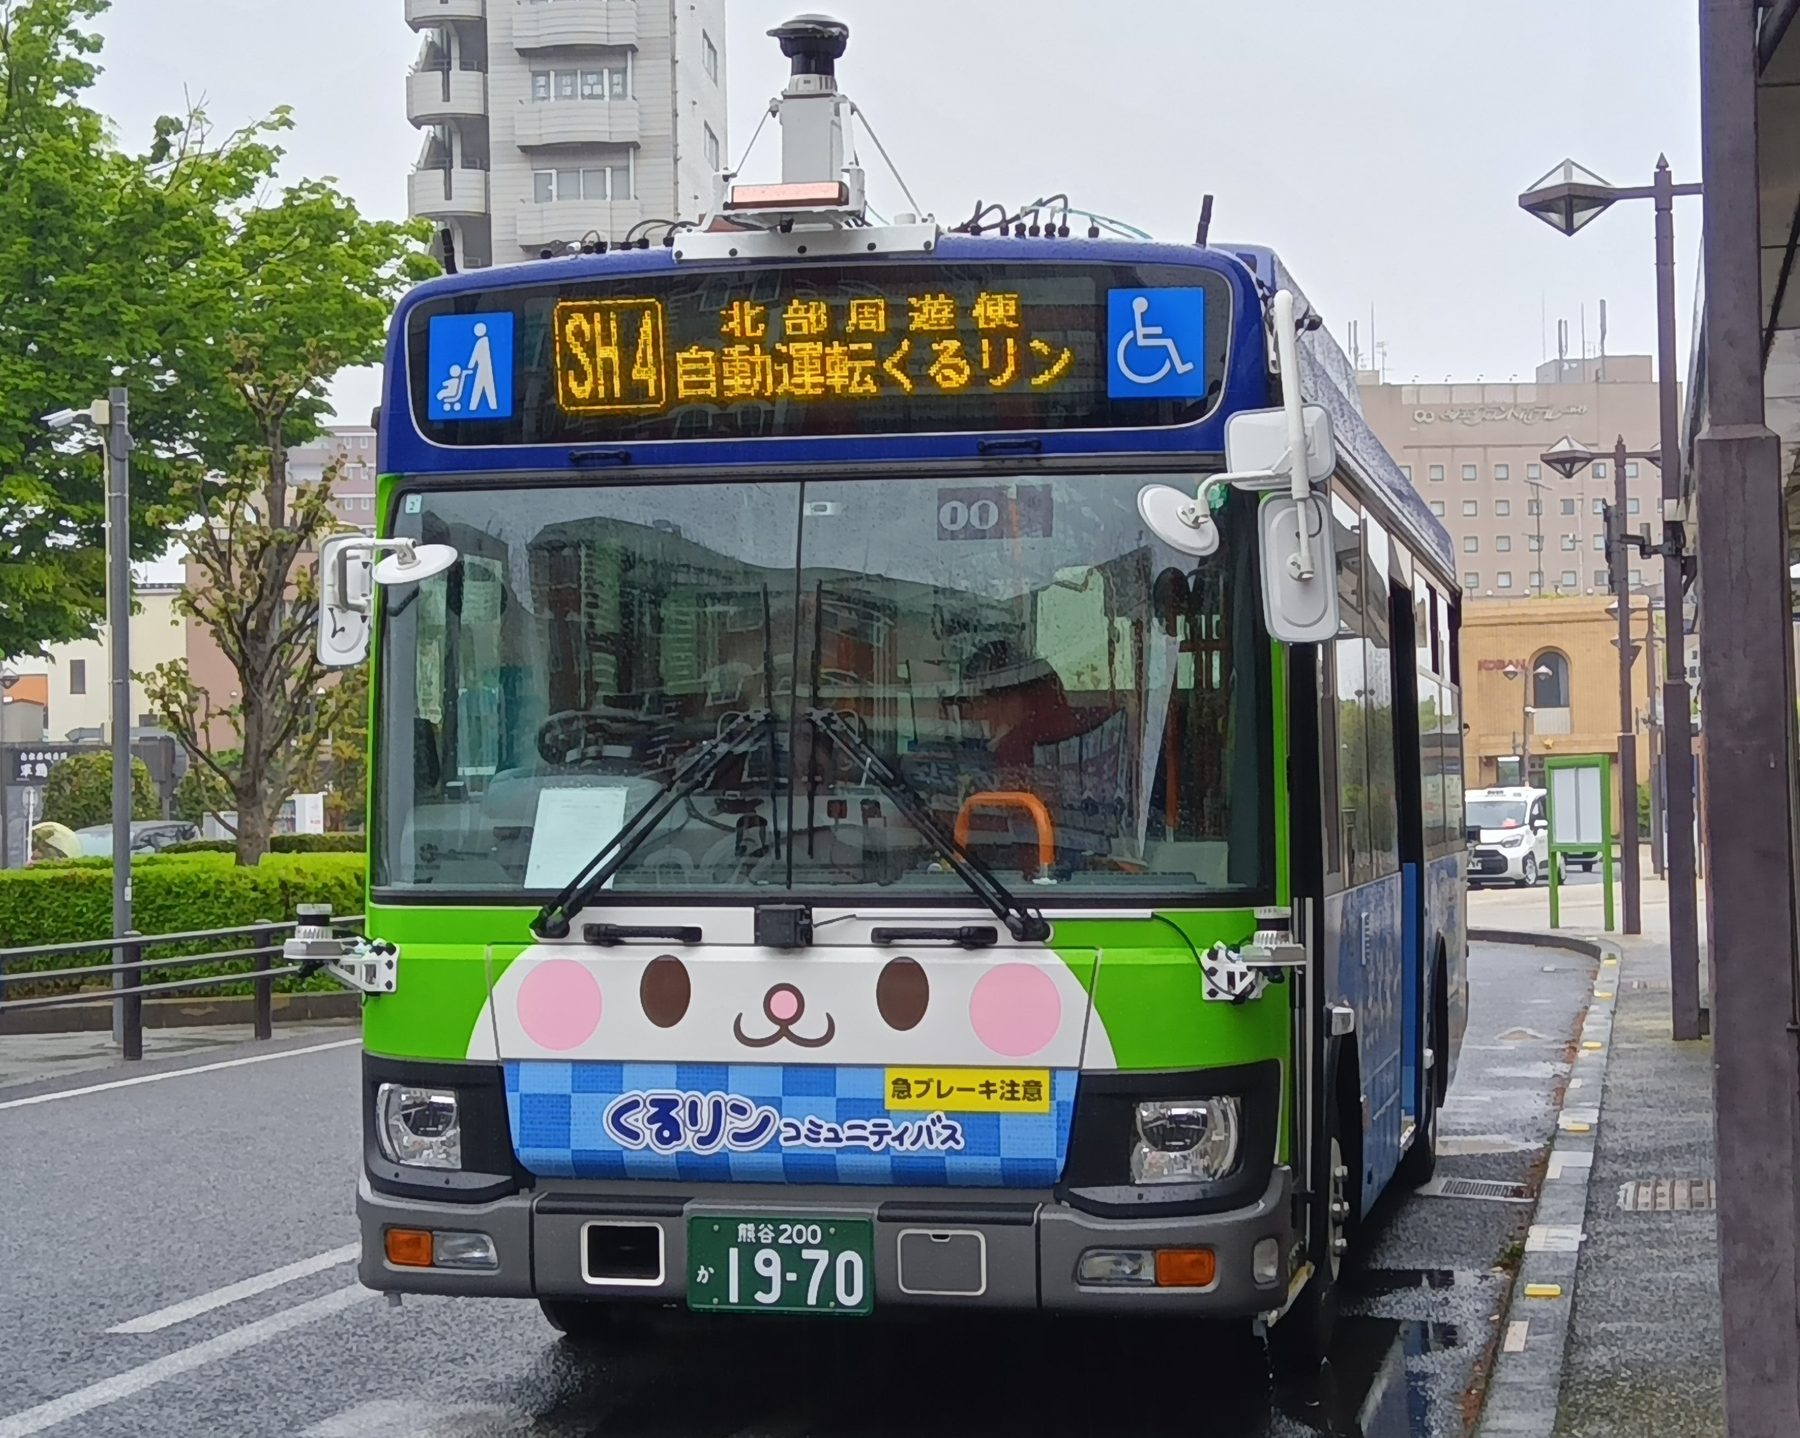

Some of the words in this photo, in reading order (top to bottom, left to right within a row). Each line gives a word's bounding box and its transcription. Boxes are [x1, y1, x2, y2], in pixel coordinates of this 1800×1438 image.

[720, 292, 1020, 337] 北部周遊便
[676, 338, 1072, 400] 自動運転くるリン
[891, 1078, 1044, 1102] 急ブレーキ注意
[606, 1093, 775, 1150] くるリン
[782, 1113, 964, 1149] コミュニティバス
[696, 1265, 715, 1284] か
[728, 1247, 864, 1307] 19-70
